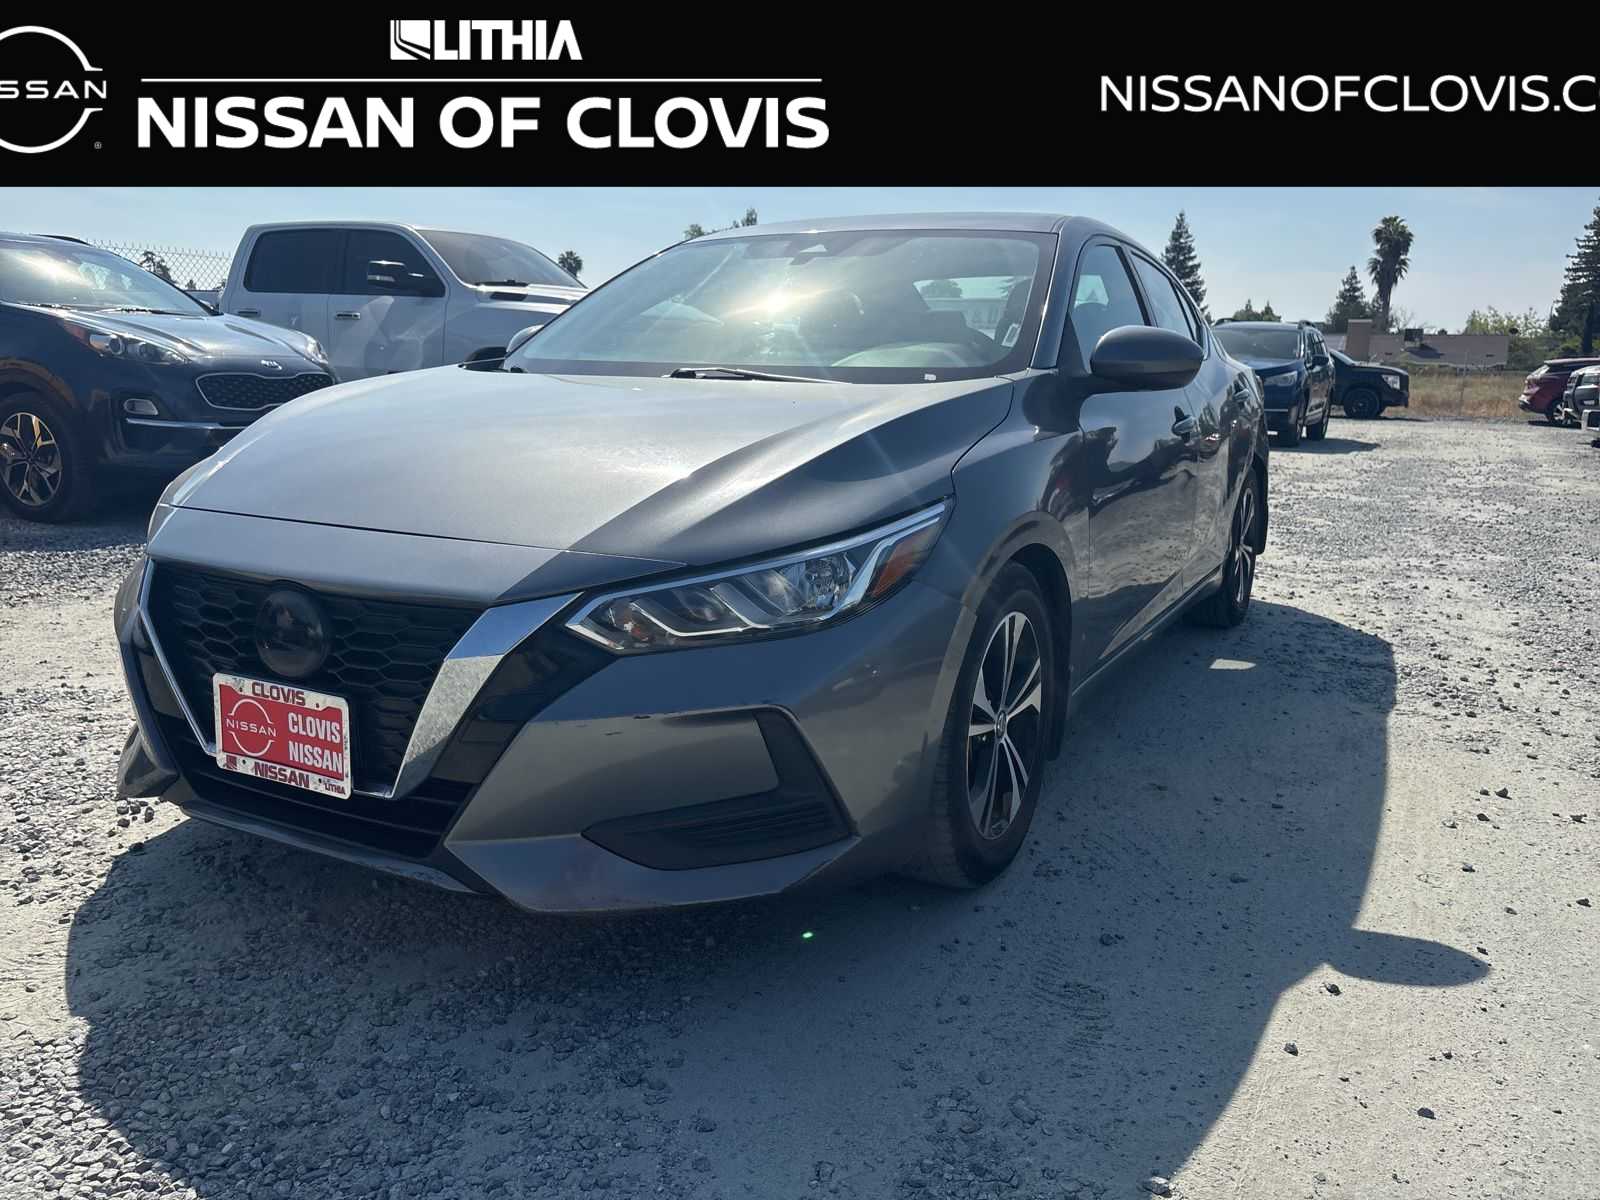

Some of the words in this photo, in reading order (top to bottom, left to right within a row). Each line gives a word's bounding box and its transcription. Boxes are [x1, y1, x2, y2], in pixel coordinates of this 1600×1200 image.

[251, 681, 306, 706] CLOVIS
[225, 718, 277, 737] NISSAN
[287, 712, 341, 744] CLOVIS
[288, 741, 343, 774] NISSAN
[253, 761, 310, 789] NISSAN
